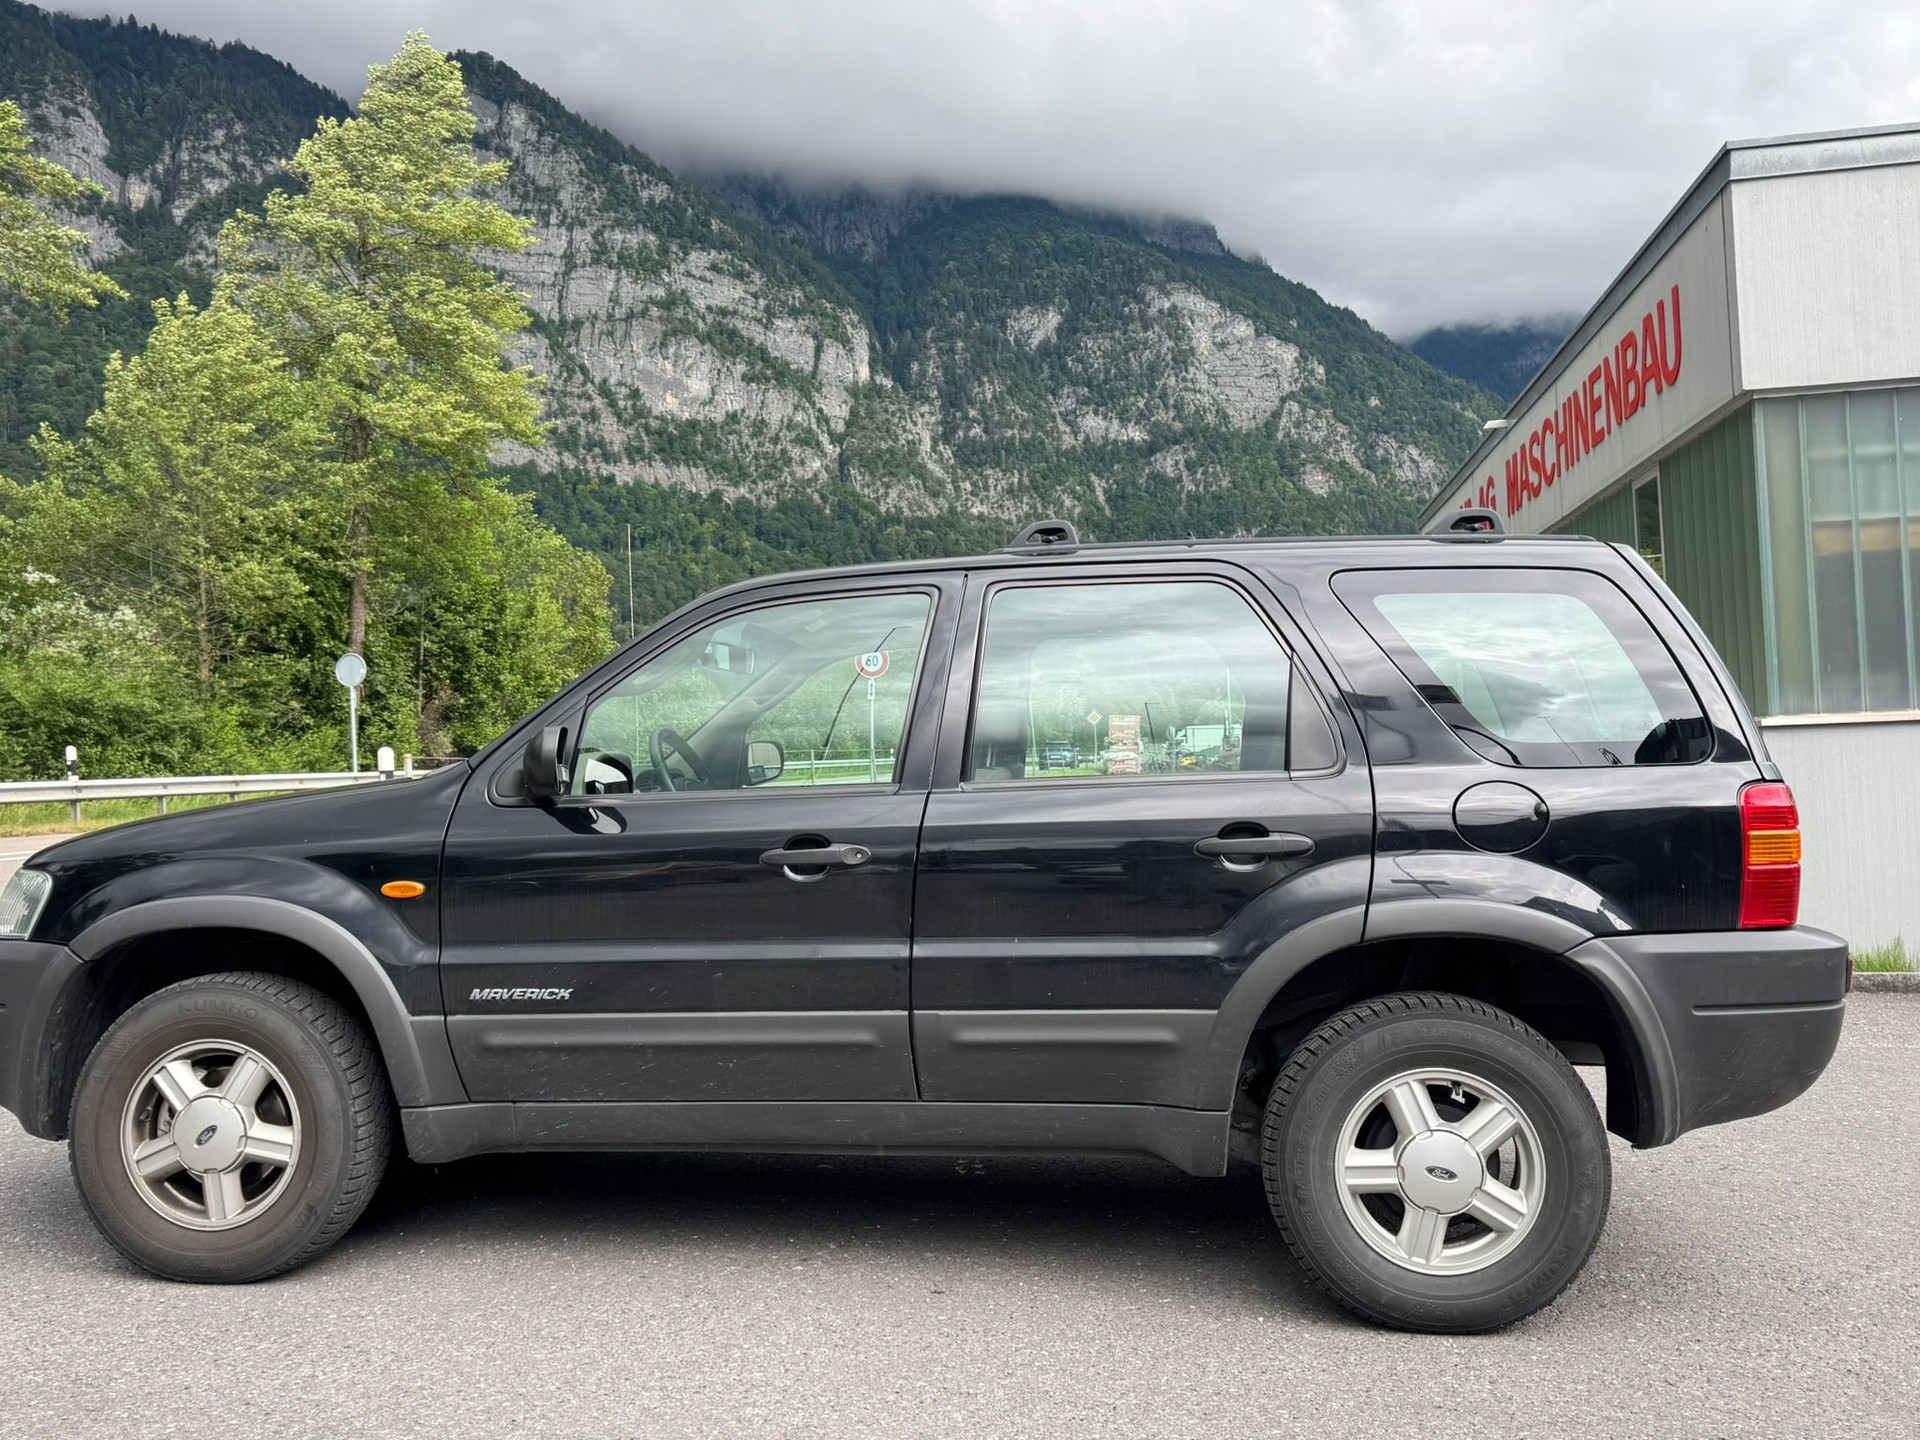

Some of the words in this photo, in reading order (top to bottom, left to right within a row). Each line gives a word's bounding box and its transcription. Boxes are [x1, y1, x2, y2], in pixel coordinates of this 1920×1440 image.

[1505, 284, 1682, 518] MASCHINENBAU
[865, 654, 879, 667] 60
[469, 988, 574, 1000] MAVERICK
